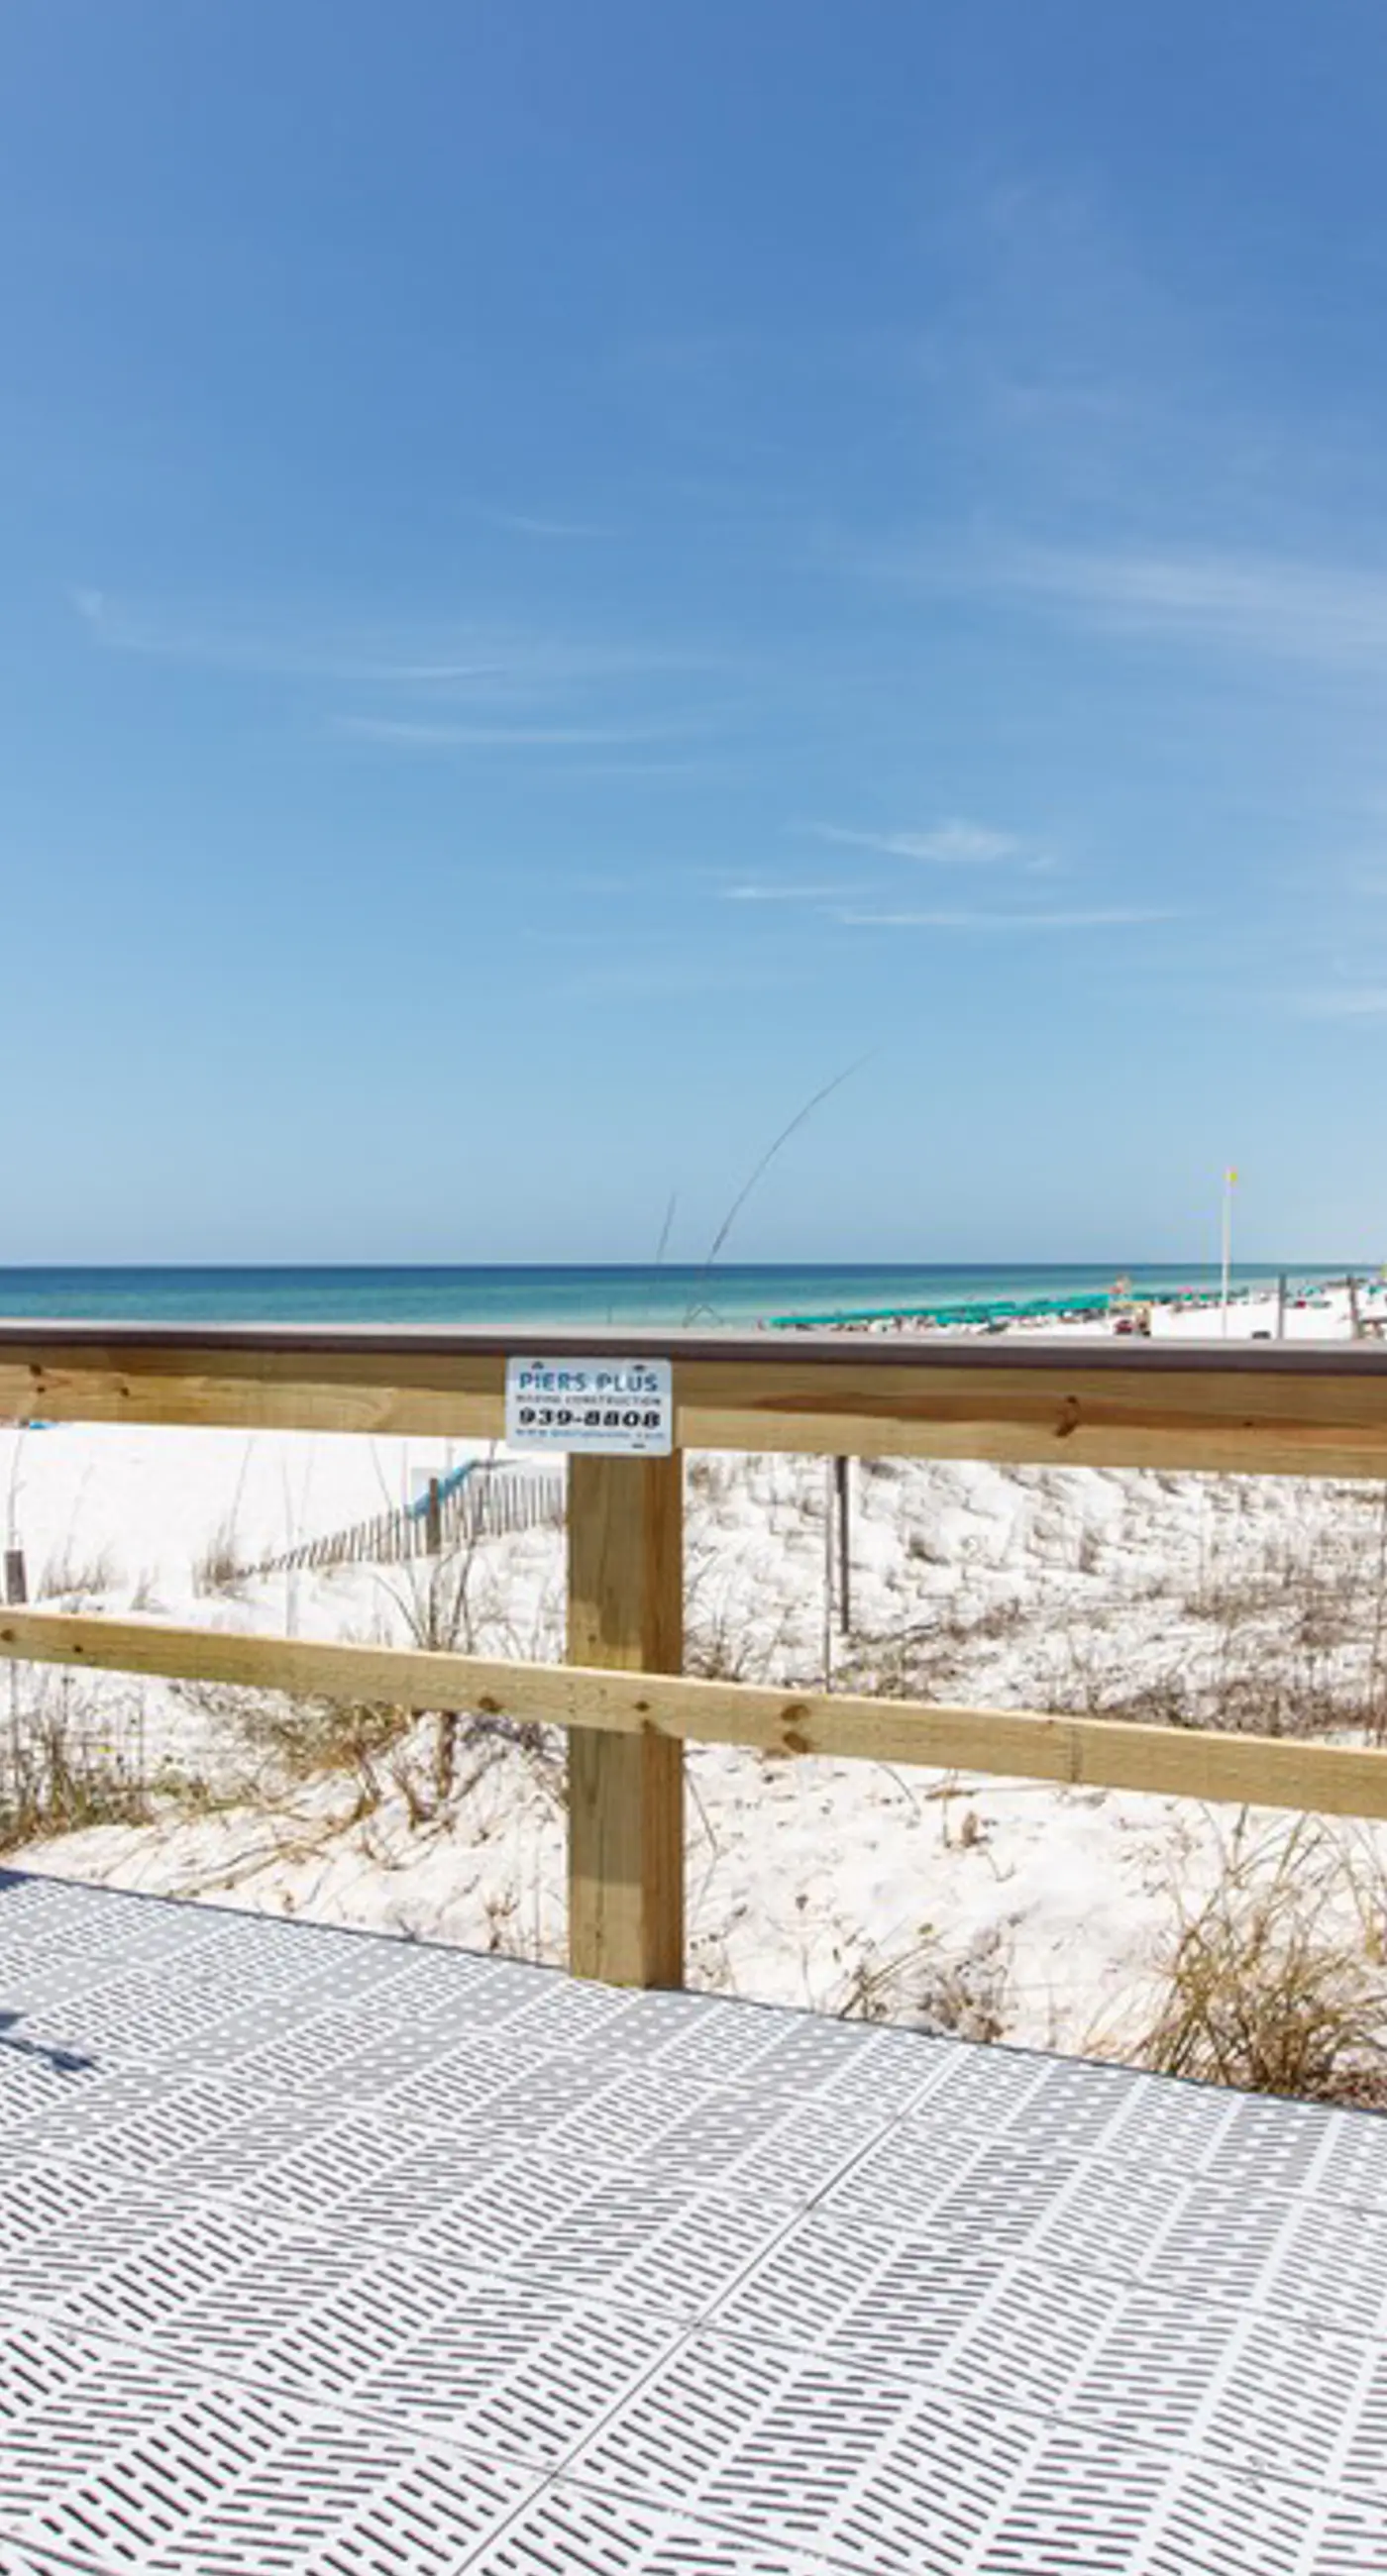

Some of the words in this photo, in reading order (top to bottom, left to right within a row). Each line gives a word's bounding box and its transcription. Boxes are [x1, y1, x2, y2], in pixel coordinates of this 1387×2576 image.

[519, 1372, 587, 1391] PIERS
[596, 1373, 659, 1392] PLUS
[565, 1395, 662, 1405] CONSTRUCTION
[519, 1407, 661, 1428] 939-8808
